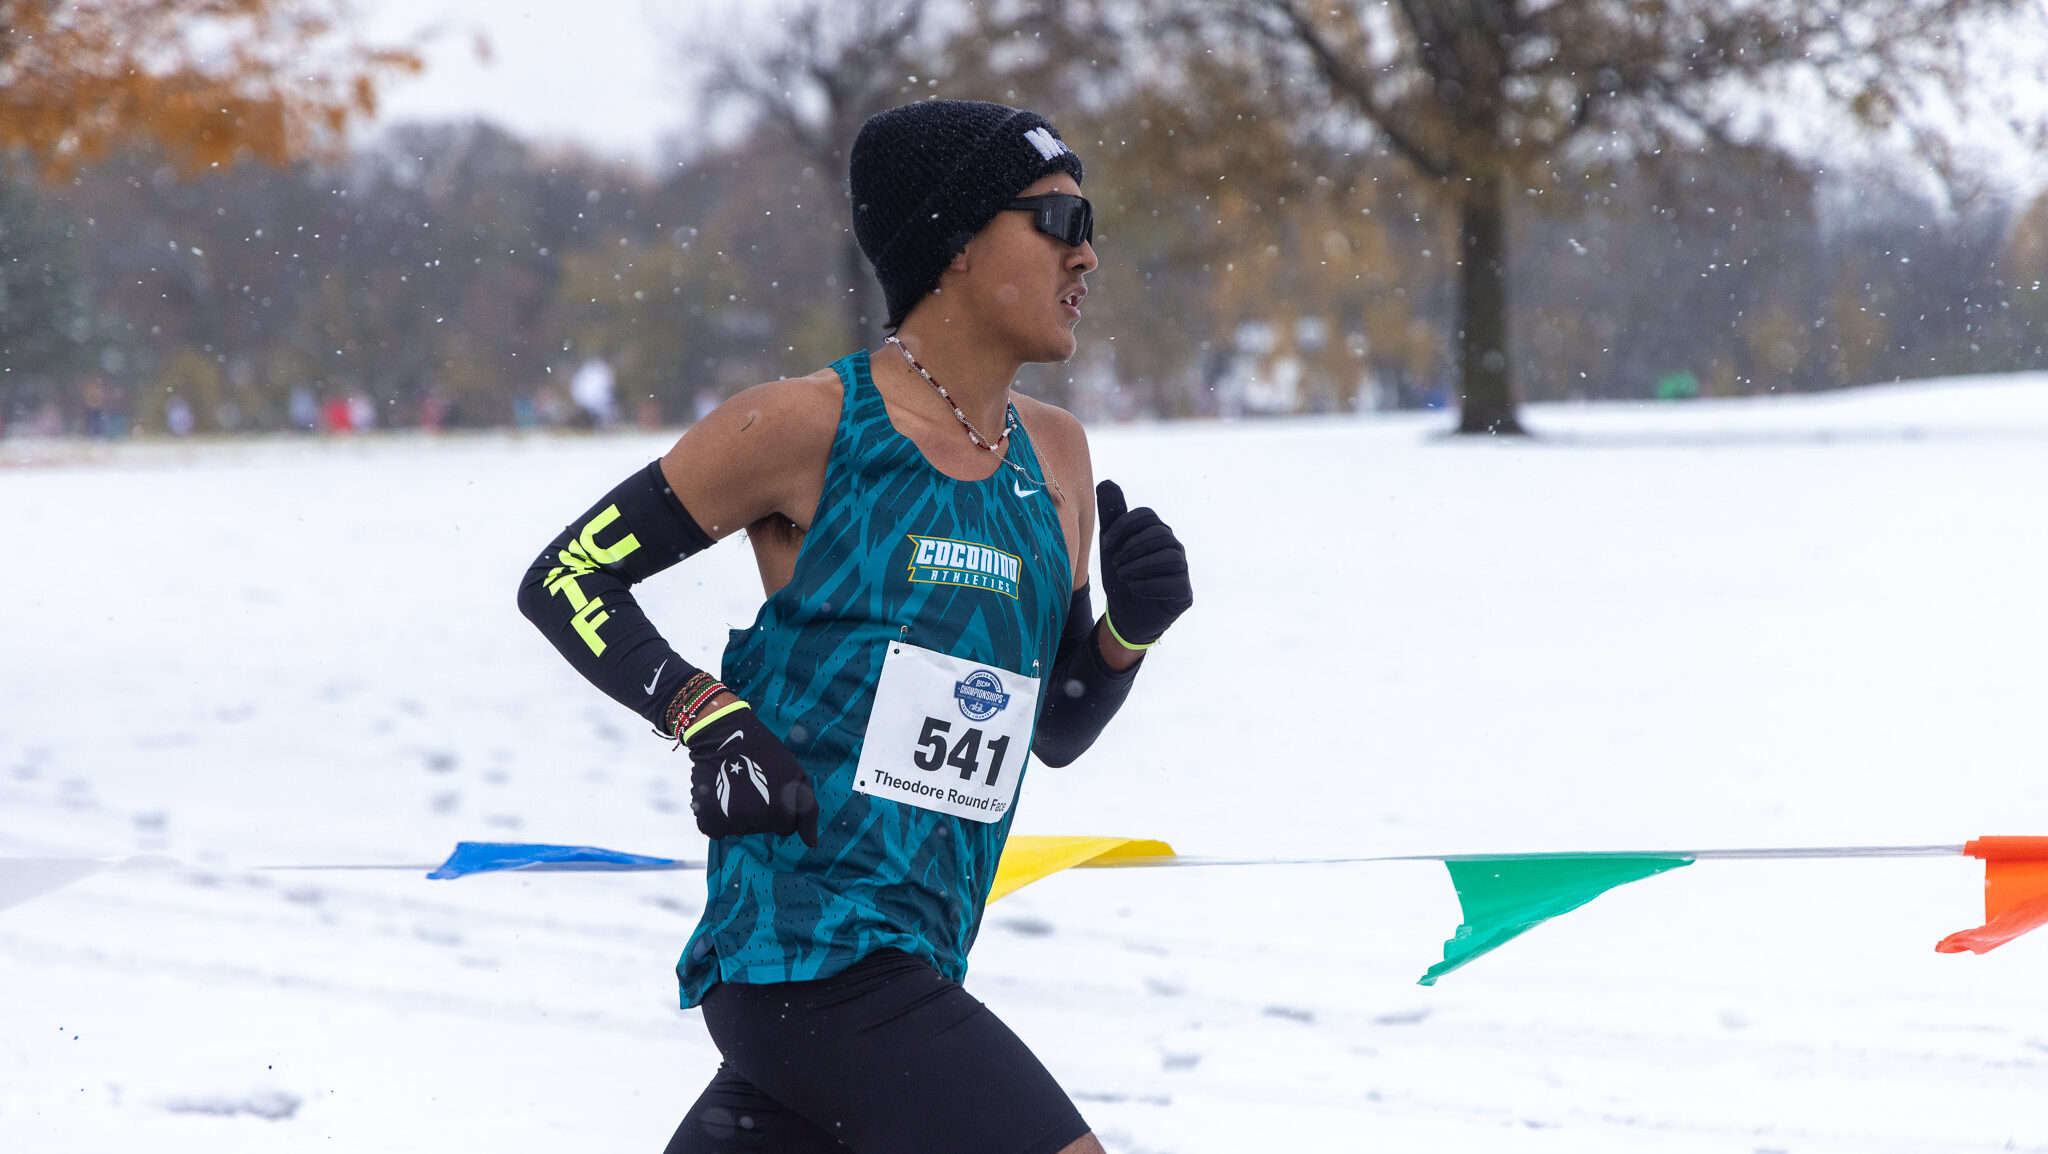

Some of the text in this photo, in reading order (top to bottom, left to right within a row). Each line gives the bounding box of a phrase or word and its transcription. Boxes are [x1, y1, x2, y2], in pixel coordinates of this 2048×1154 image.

[915, 539, 1018, 583] COCONINO
[930, 569, 1010, 593] ATHLETICS
[959, 684, 1004, 704] CHAMPIONSHIPS
[913, 716, 1011, 787] 541
[874, 769, 944, 799] Theodore
[947, 788, 990, 810] Round
